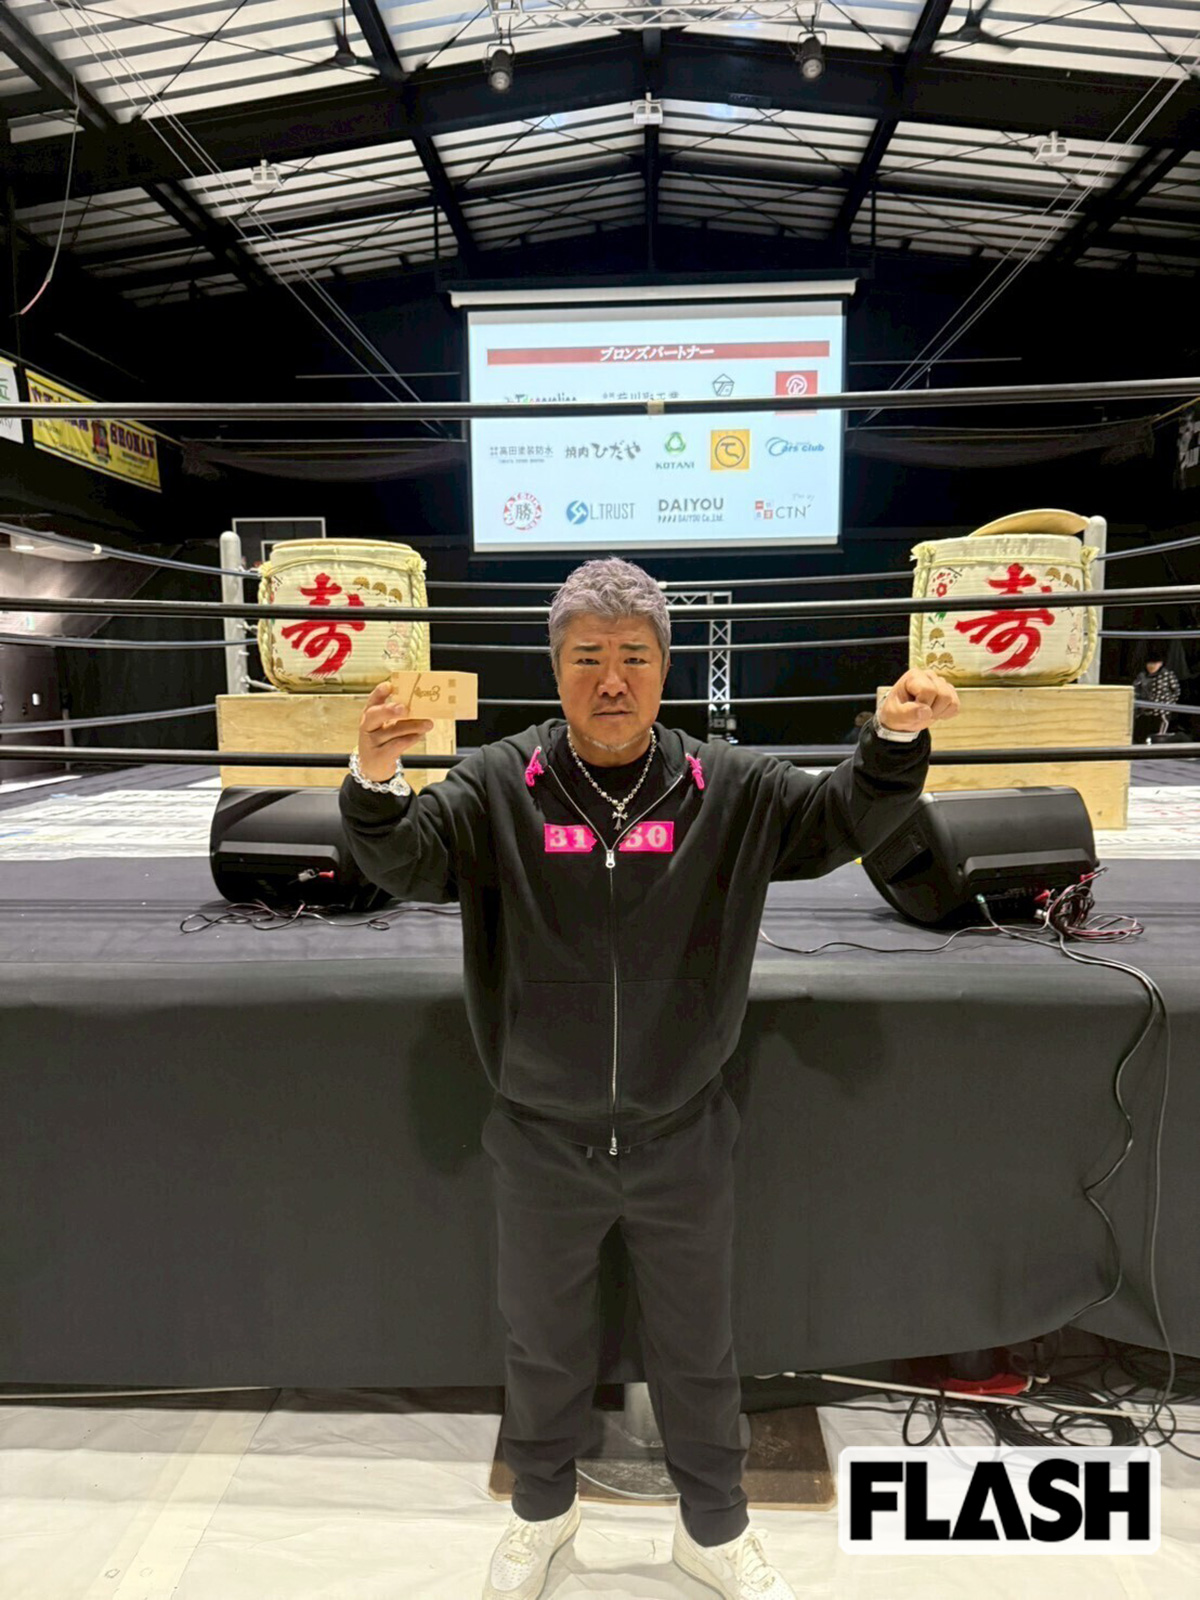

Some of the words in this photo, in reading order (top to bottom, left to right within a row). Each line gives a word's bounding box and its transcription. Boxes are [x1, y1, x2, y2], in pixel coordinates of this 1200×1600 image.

[600, 346, 715, 362] ブロンズパートナー
[110, 423, 155, 459] SHOKAN
[801, 443, 825, 452] club
[655, 461, 695, 470] KOTANI
[514, 503, 533, 521] 勝
[590, 503, 635, 520] L.TRUST
[658, 498, 724, 512] DAIYOU
[550, 828, 588, 848] 31
